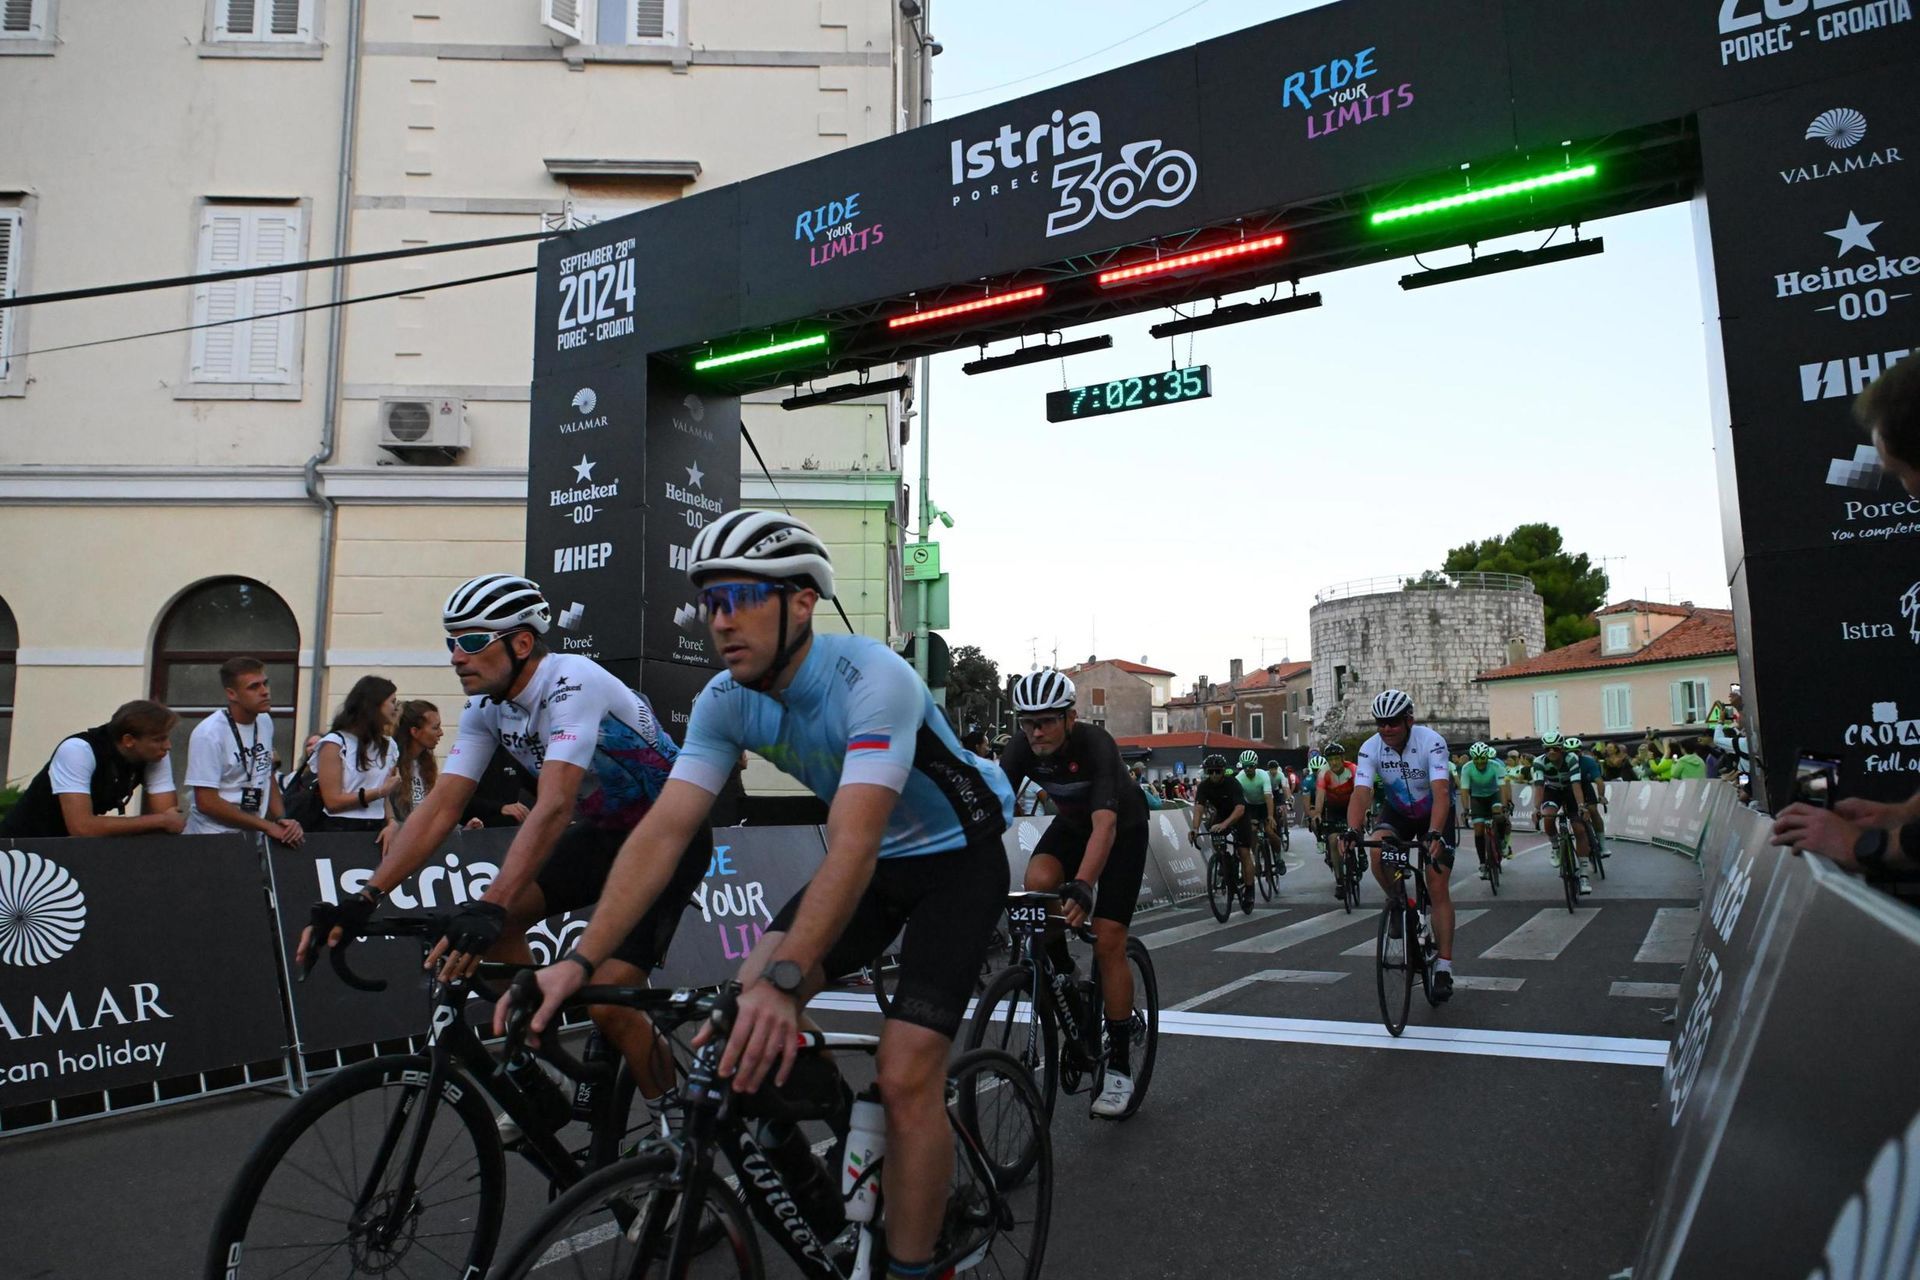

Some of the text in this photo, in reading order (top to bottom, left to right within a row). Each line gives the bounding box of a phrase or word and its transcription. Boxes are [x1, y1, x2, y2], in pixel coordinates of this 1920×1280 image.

[1720, 22, 1793, 66] POREČ
[1817, 0, 1912, 42] CROATIA
[1283, 47, 1378, 110] RIDE
[1328, 83, 1369, 107] YOUR
[1308, 83, 1414, 139] LIMITS
[951, 109, 1102, 186] Istria
[1779, 147, 1904, 185] VALAMAR
[952, 170, 1039, 206] POREČ
[794, 192, 861, 242] RIDE
[826, 222, 854, 242] YOUR
[810, 223, 884, 268] LIMITS
[560, 245, 613, 276] SEPTEMBER
[558, 258, 636, 330] 2024
[597, 316, 635, 341] CROATIA
[1069, 366, 1202, 415] 7:02:35
[559, 416, 609, 434] VALAMAR
[672, 418, 714, 442] VALAMAR
[550, 481, 619, 507] Heineken
[665, 482, 722, 513] Heineken
[1845, 495, 1920, 521] Poreč
[1831, 522, 1920, 541] You complete
[574, 542, 613, 570] HEP
[563, 635, 593, 650] Poreč
[1841, 621, 1895, 640] Istra
[679, 636, 704, 652] Poreč
[671, 710, 689, 723] Istra
[1381, 760, 1409, 770] Istria
[1865, 751, 1904, 773] Full
[1381, 851, 1407, 861] 2516
[692, 882, 774, 923] YOUR
[1011, 907, 1046, 921] 3215
[58, 1039, 167, 1074] holiday
